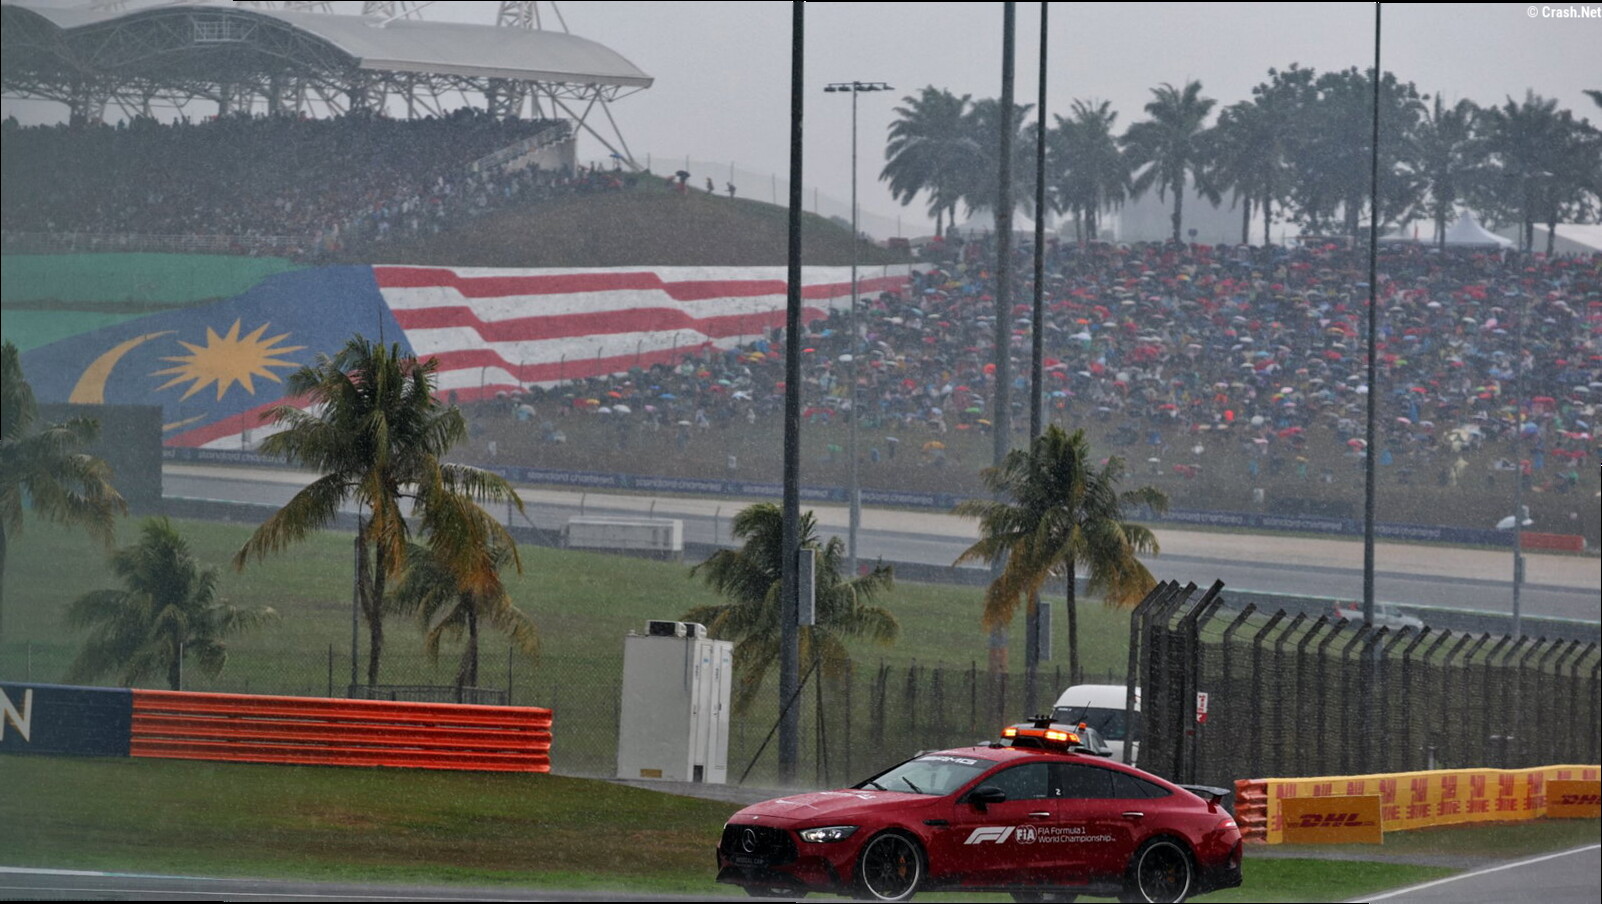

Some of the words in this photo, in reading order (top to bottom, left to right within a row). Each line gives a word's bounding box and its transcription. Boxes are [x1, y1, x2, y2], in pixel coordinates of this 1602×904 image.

[1055, 788, 1062, 796] 2
[1561, 794, 1601, 805] DH
[1299, 813, 1362, 828] DHL
[1016, 828, 1035, 841] FIA
[1038, 827, 1050, 835] FIA
[1050, 826, 1081, 835] Formula
[1081, 826, 1086, 834] 1
[1038, 835, 1060, 844] World
[1060, 834, 1112, 843] Championship
